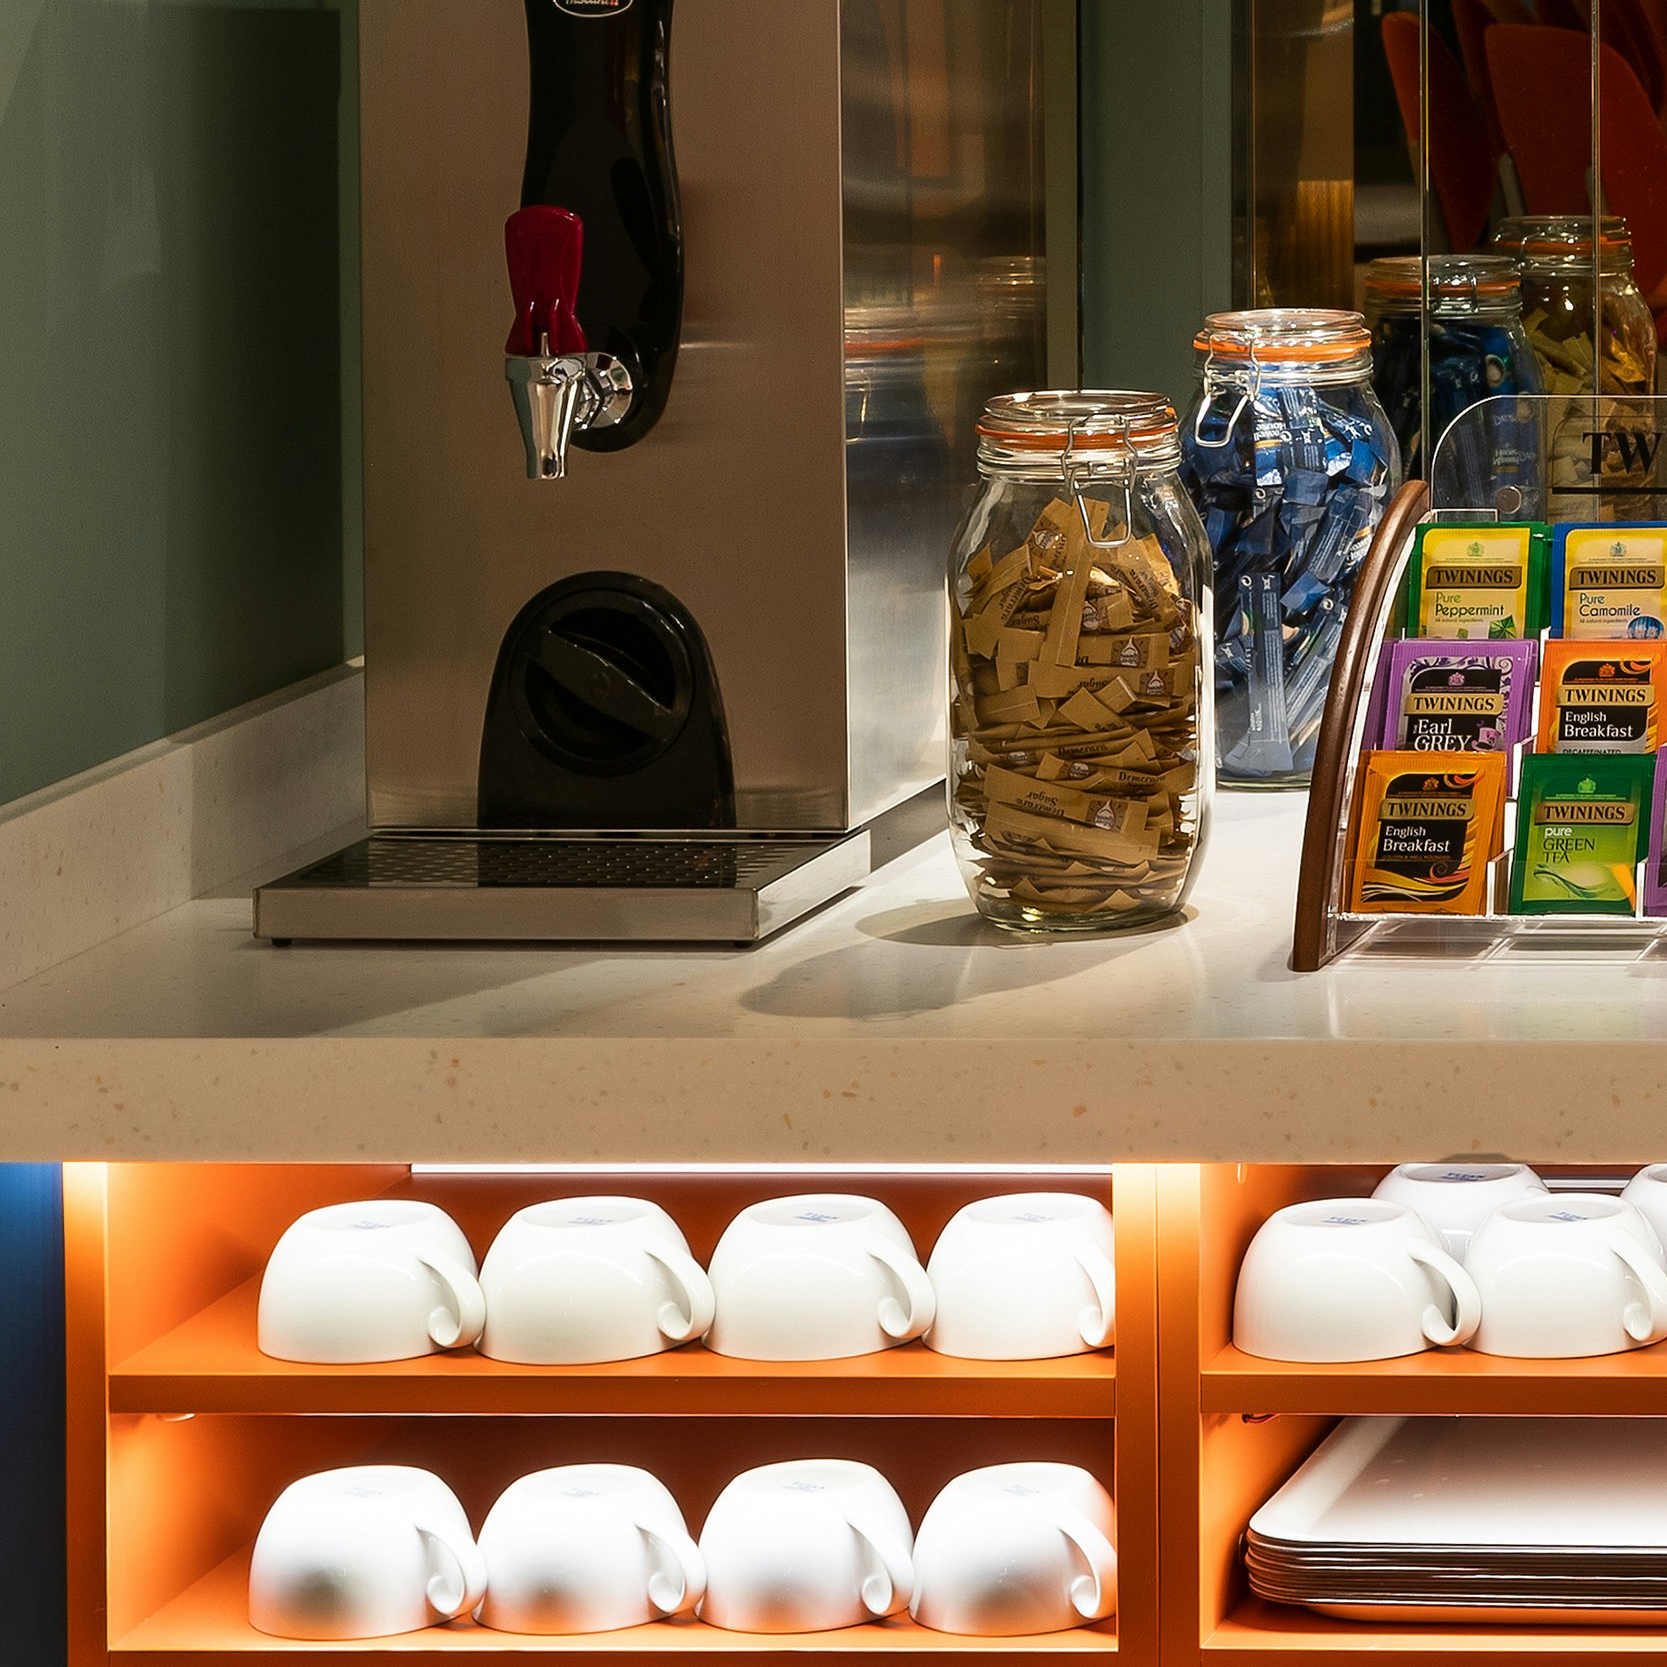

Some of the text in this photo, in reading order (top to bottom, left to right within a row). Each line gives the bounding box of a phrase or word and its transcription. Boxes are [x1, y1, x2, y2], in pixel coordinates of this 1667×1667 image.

[1434, 569, 1514, 585] TWININGS
[1577, 569, 1657, 585] TWININGS
[1435, 592, 1462, 604] Pure
[1579, 592, 1605, 604] Pure
[1435, 604, 1505, 619] Peppermint
[1579, 604, 1641, 617] Camomile
[1564, 688, 1646, 703] TWININGS
[1413, 697, 1495, 712] TWININGS
[1565, 711, 1607, 724] English
[1418, 718, 1453, 734] Earl
[1564, 724, 1634, 739] Breakfast
[1414, 735, 1472, 752] GREY
[1028, 791, 1059, 807] Sugar
[1388, 802, 1467, 817] TWININGS
[1544, 805, 1625, 820] TWININGS
[1385, 825, 1427, 839] English
[1544, 826, 1573, 837] pure
[1383, 838, 1450, 853] Breakfast
[1543, 838, 1595, 851] GREEN
[1543, 852, 1571, 864] TEA
